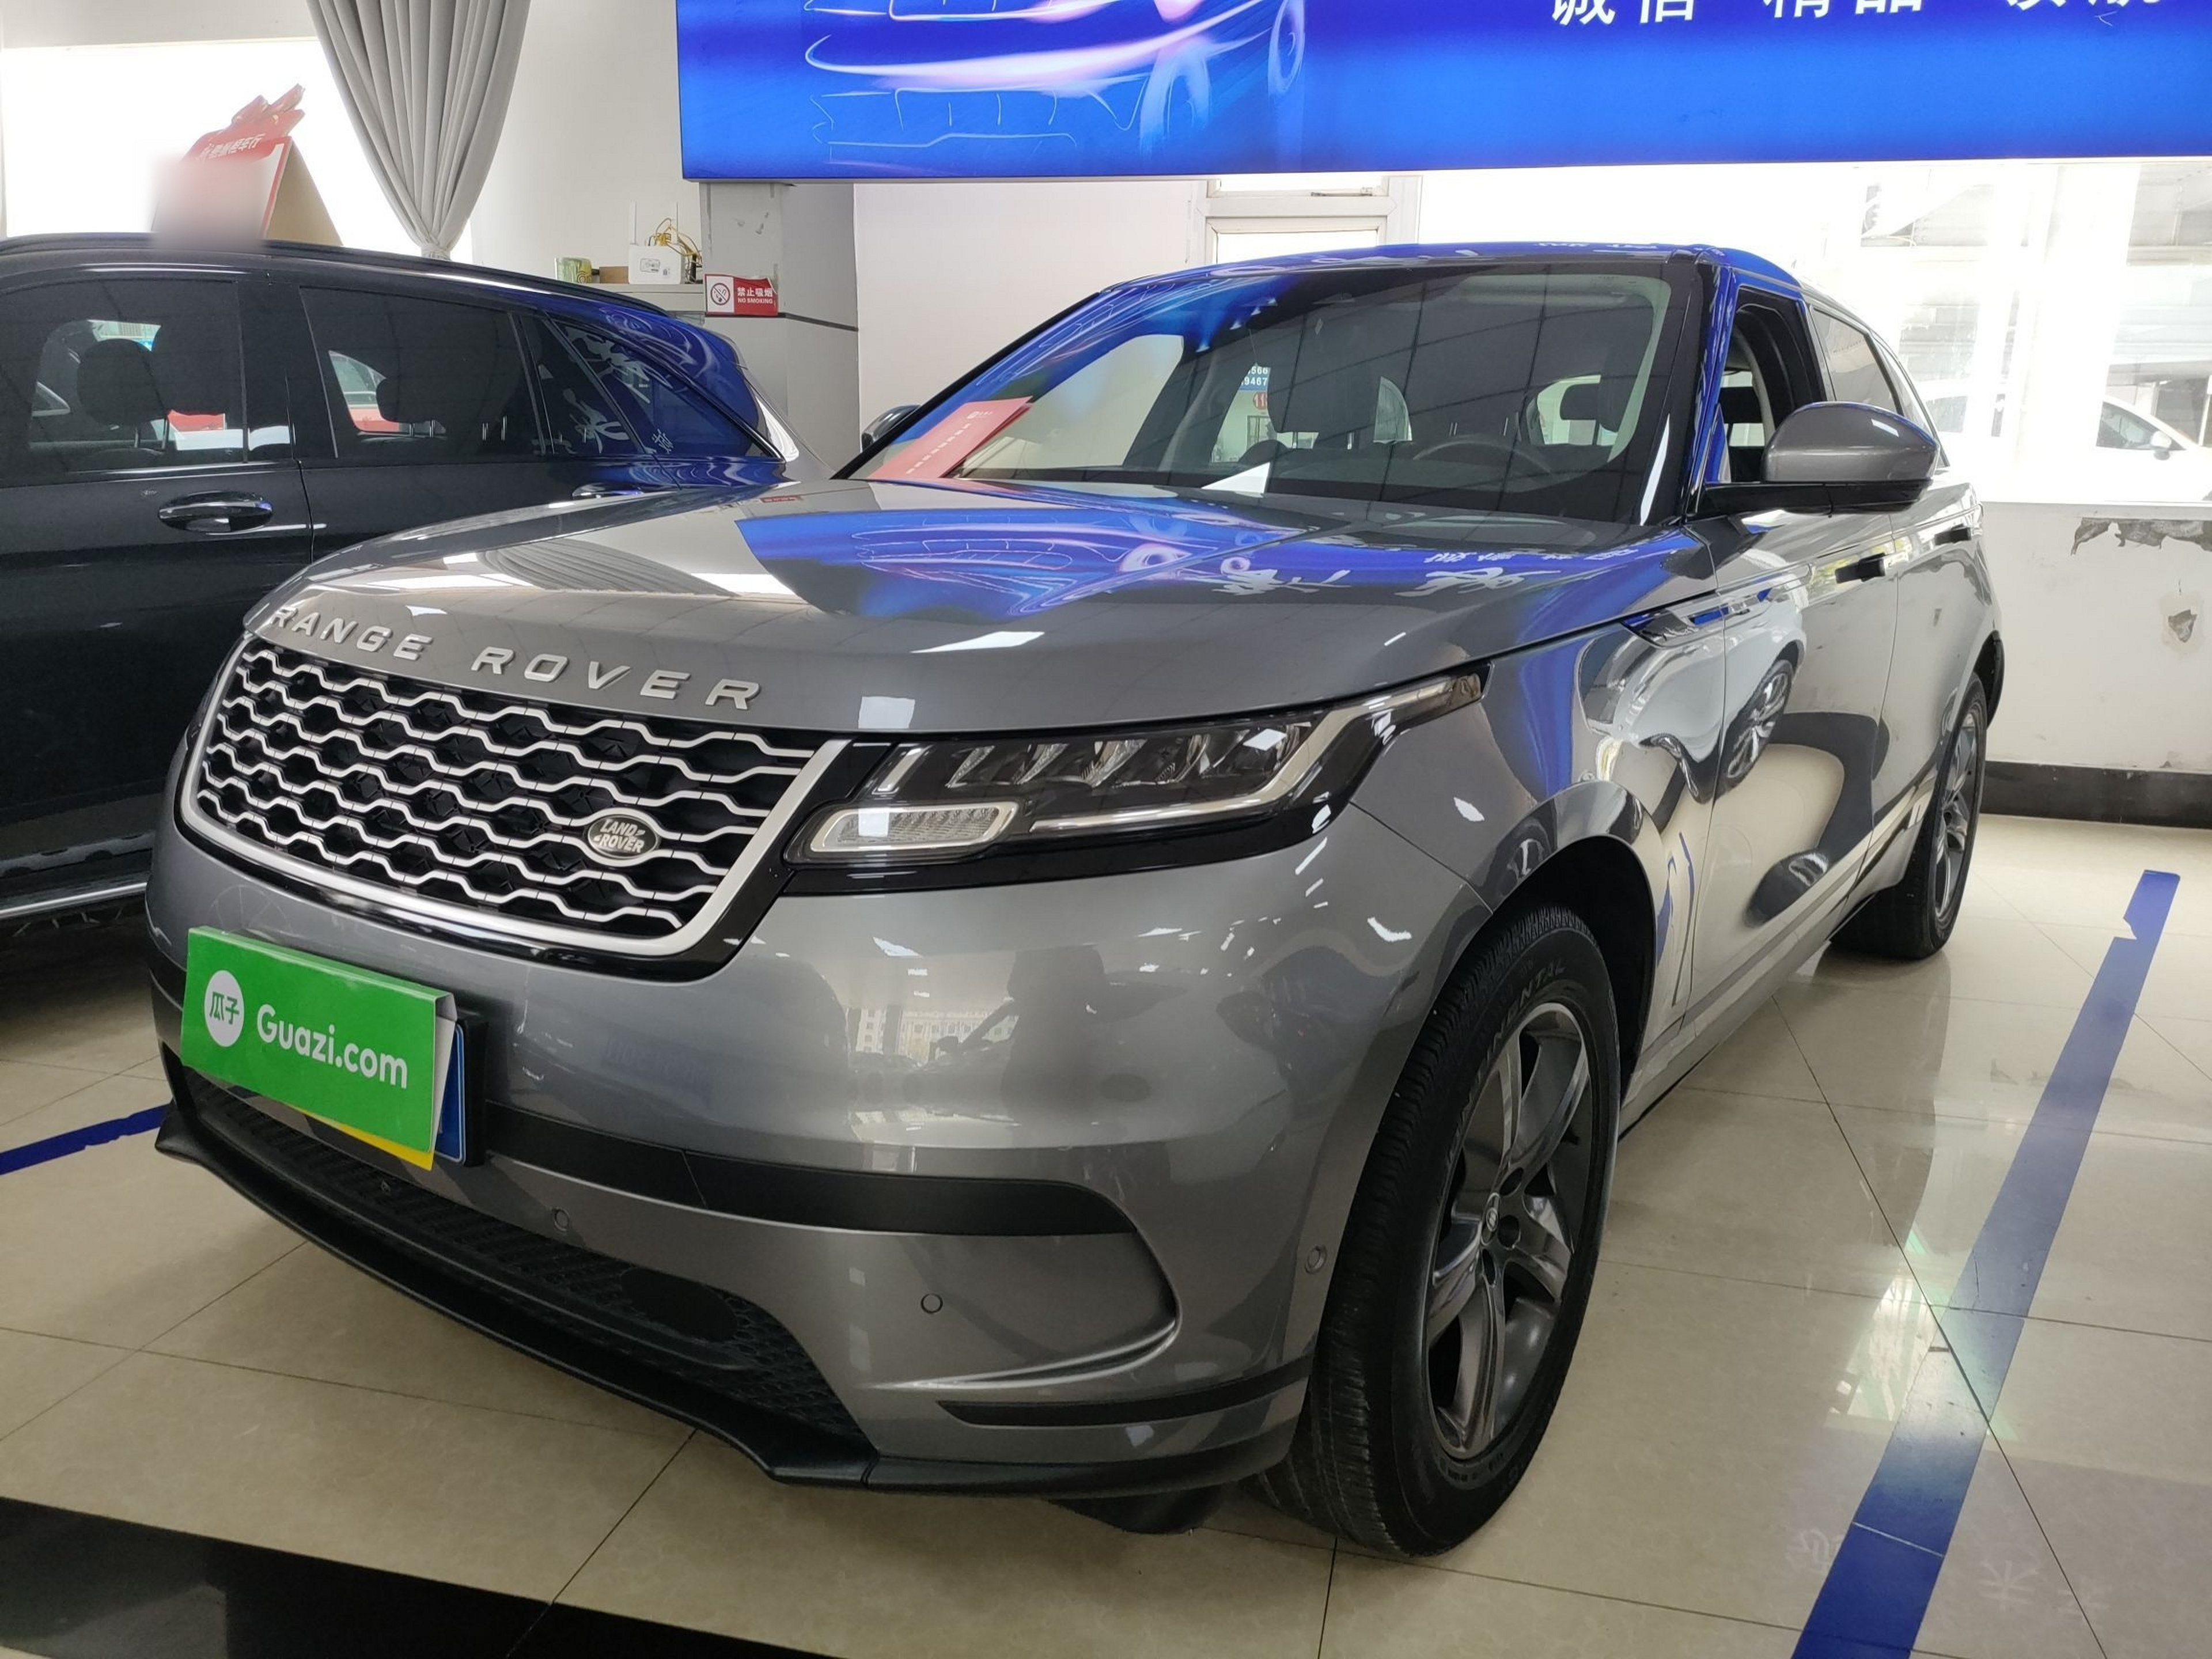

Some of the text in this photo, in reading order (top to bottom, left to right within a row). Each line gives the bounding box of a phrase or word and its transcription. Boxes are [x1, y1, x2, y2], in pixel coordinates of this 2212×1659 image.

[737, 287, 773, 297] 禁止吸烟
[1241, 376, 1268, 386] 9467
[1254, 393, 1267, 407] 11
[270, 605, 763, 711] RANGE ROVER
[600, 819, 638, 836] LAND
[599, 834, 645, 853] ROVER
[209, 991, 240, 1025] 瓜子
[257, 1003, 408, 1090] Guazi.com
